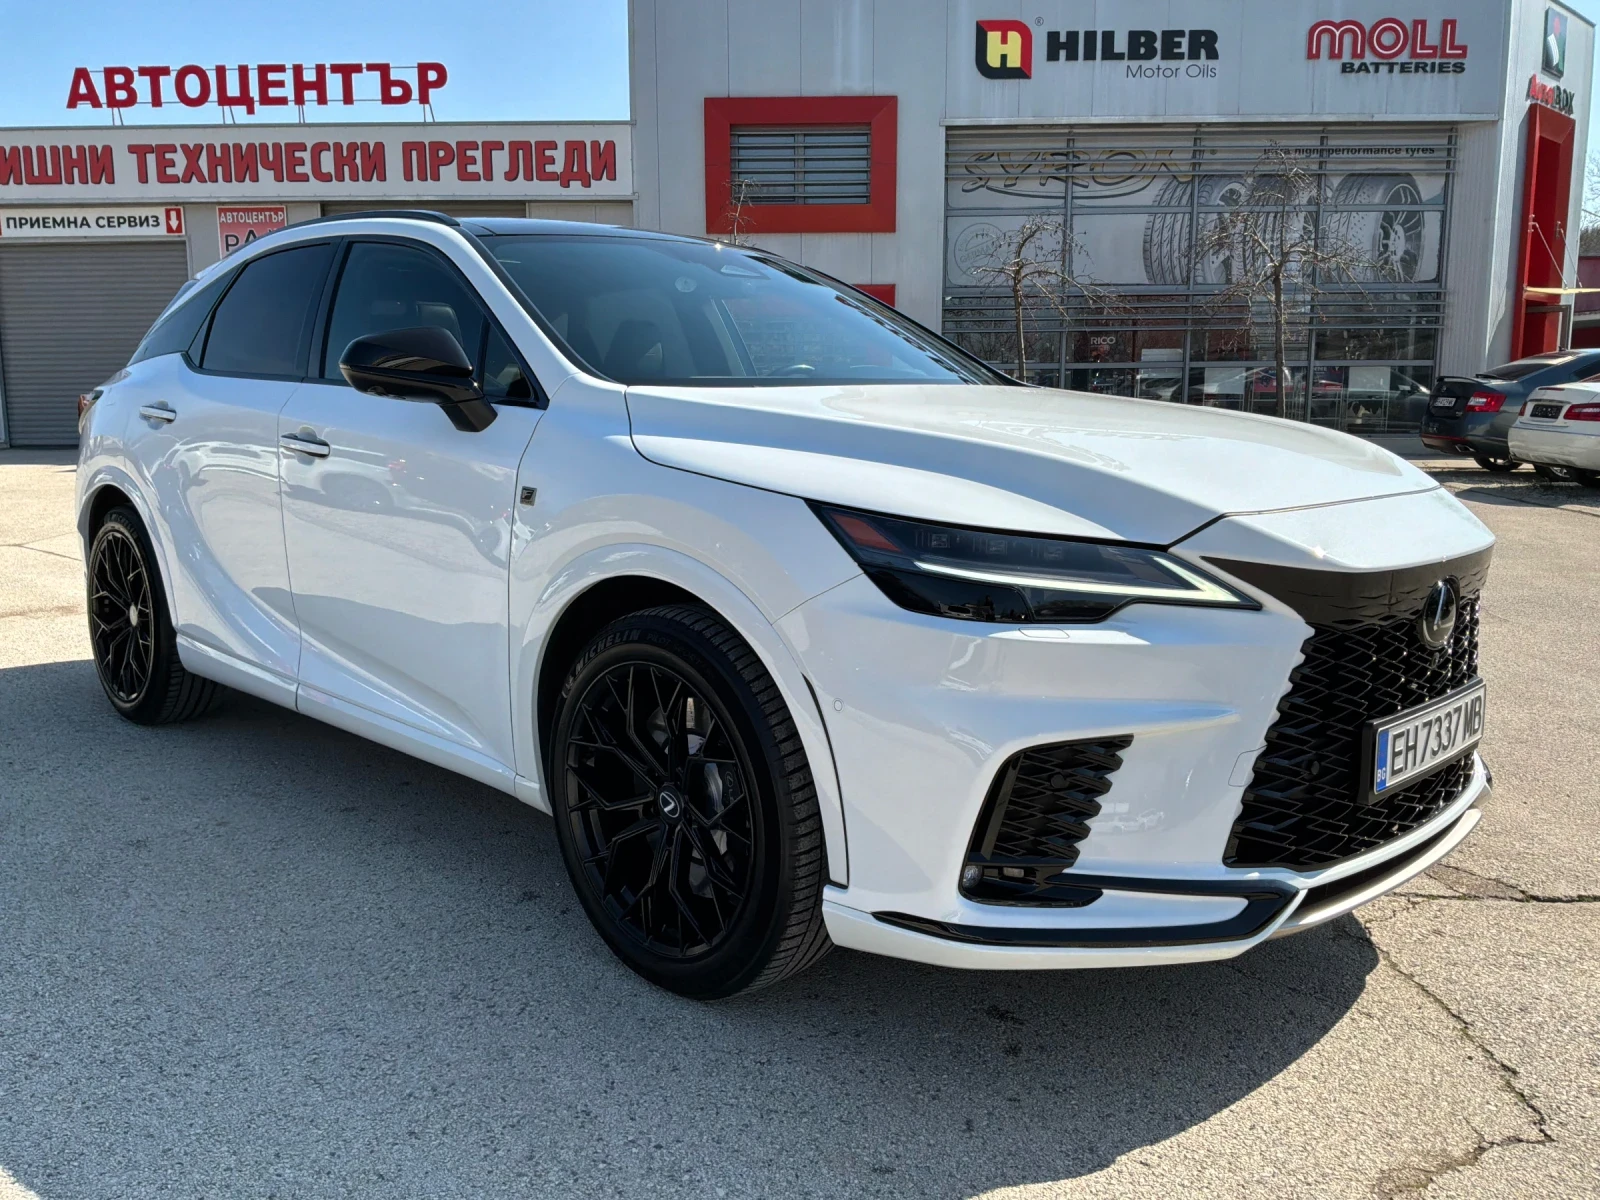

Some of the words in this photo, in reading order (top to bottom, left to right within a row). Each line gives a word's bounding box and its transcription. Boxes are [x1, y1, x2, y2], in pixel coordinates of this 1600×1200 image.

[1046, 30, 1219, 62] HILBER
[1126, 64, 1180, 79] Motor
[1185, 63, 1217, 79] Oils
[1340, 61, 1466, 74] BATTERIES
[66, 62, 448, 115] АВТОЦЕНТЪР
[127, 141, 387, 184] ТЕХНИЧЕСКИ
[402, 139, 617, 188] ПРЕГЛЕДИ
[6, 215, 91, 230] ПРИЕМНА
[95, 214, 161, 229] СЕРВИЗ
[219, 210, 284, 225] АВТОЦЕНТЪР
[1090, 336, 1116, 345] RICO
